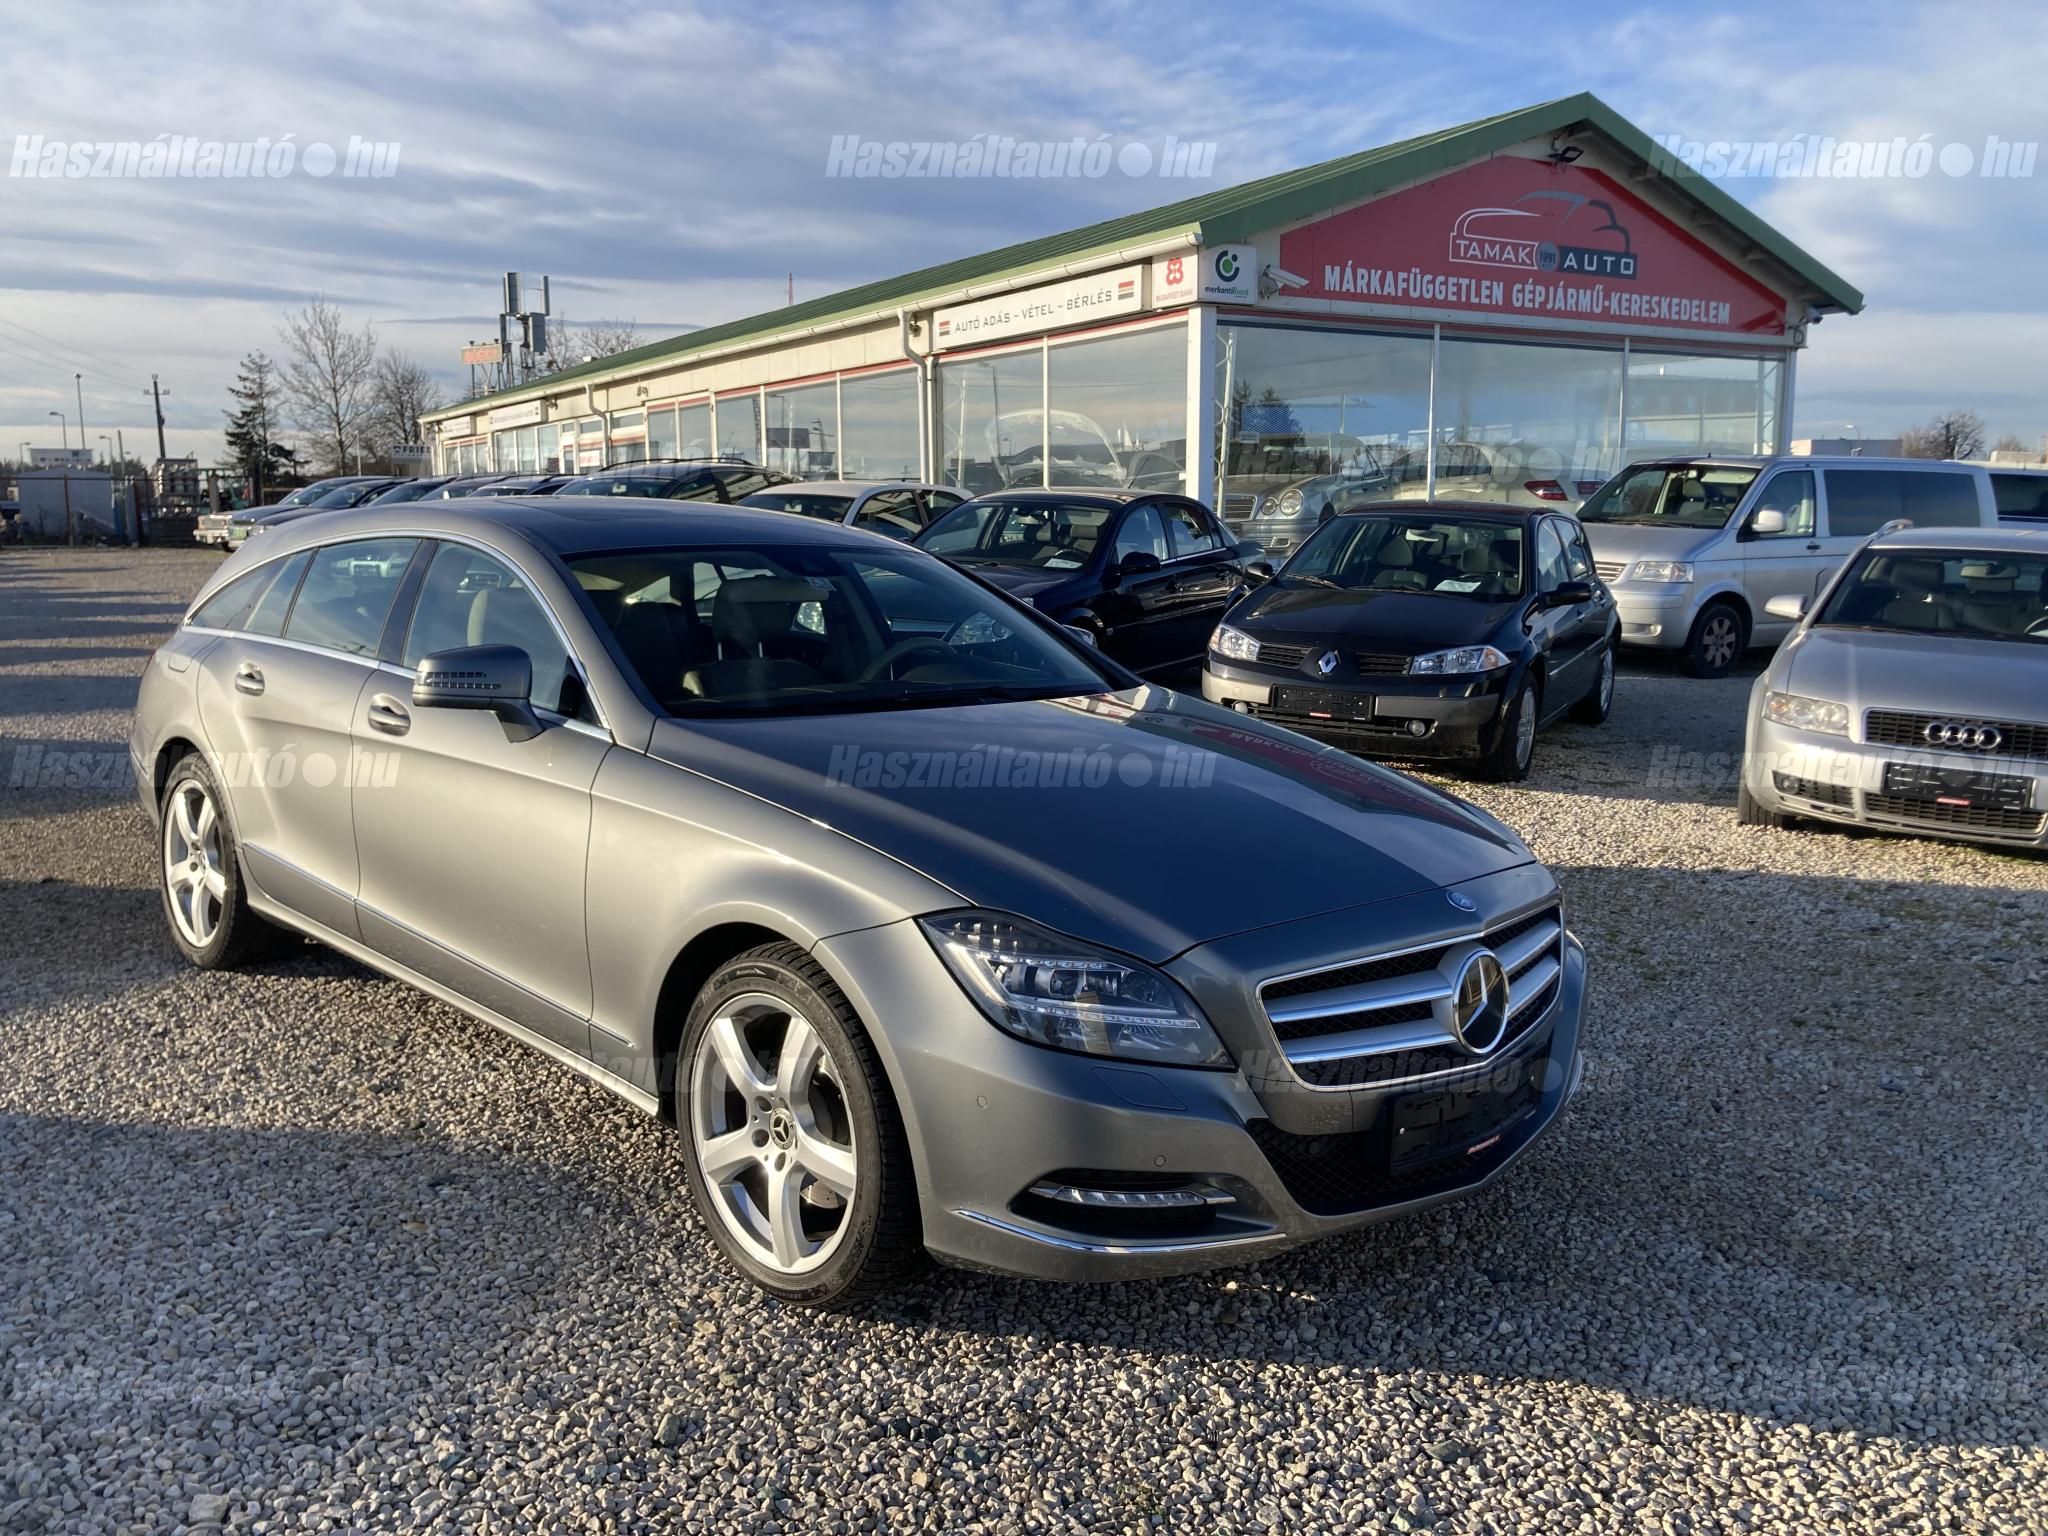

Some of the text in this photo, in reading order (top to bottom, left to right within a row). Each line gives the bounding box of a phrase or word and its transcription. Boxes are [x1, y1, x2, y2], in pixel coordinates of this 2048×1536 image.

[1456, 240, 1531, 264] TAMAK
[1564, 252, 1634, 275] AUTO
[955, 315, 980, 333] AUTÓ
[983, 311, 1010, 328] ADÁS
[1021, 304, 1054, 320] VÉTEL
[1066, 288, 1112, 310] BÉRLÉS
[1324, 260, 1730, 325] MÁRKAFÜGGETLEN GÉPJÁRMŰ-KERESKEDELEM
